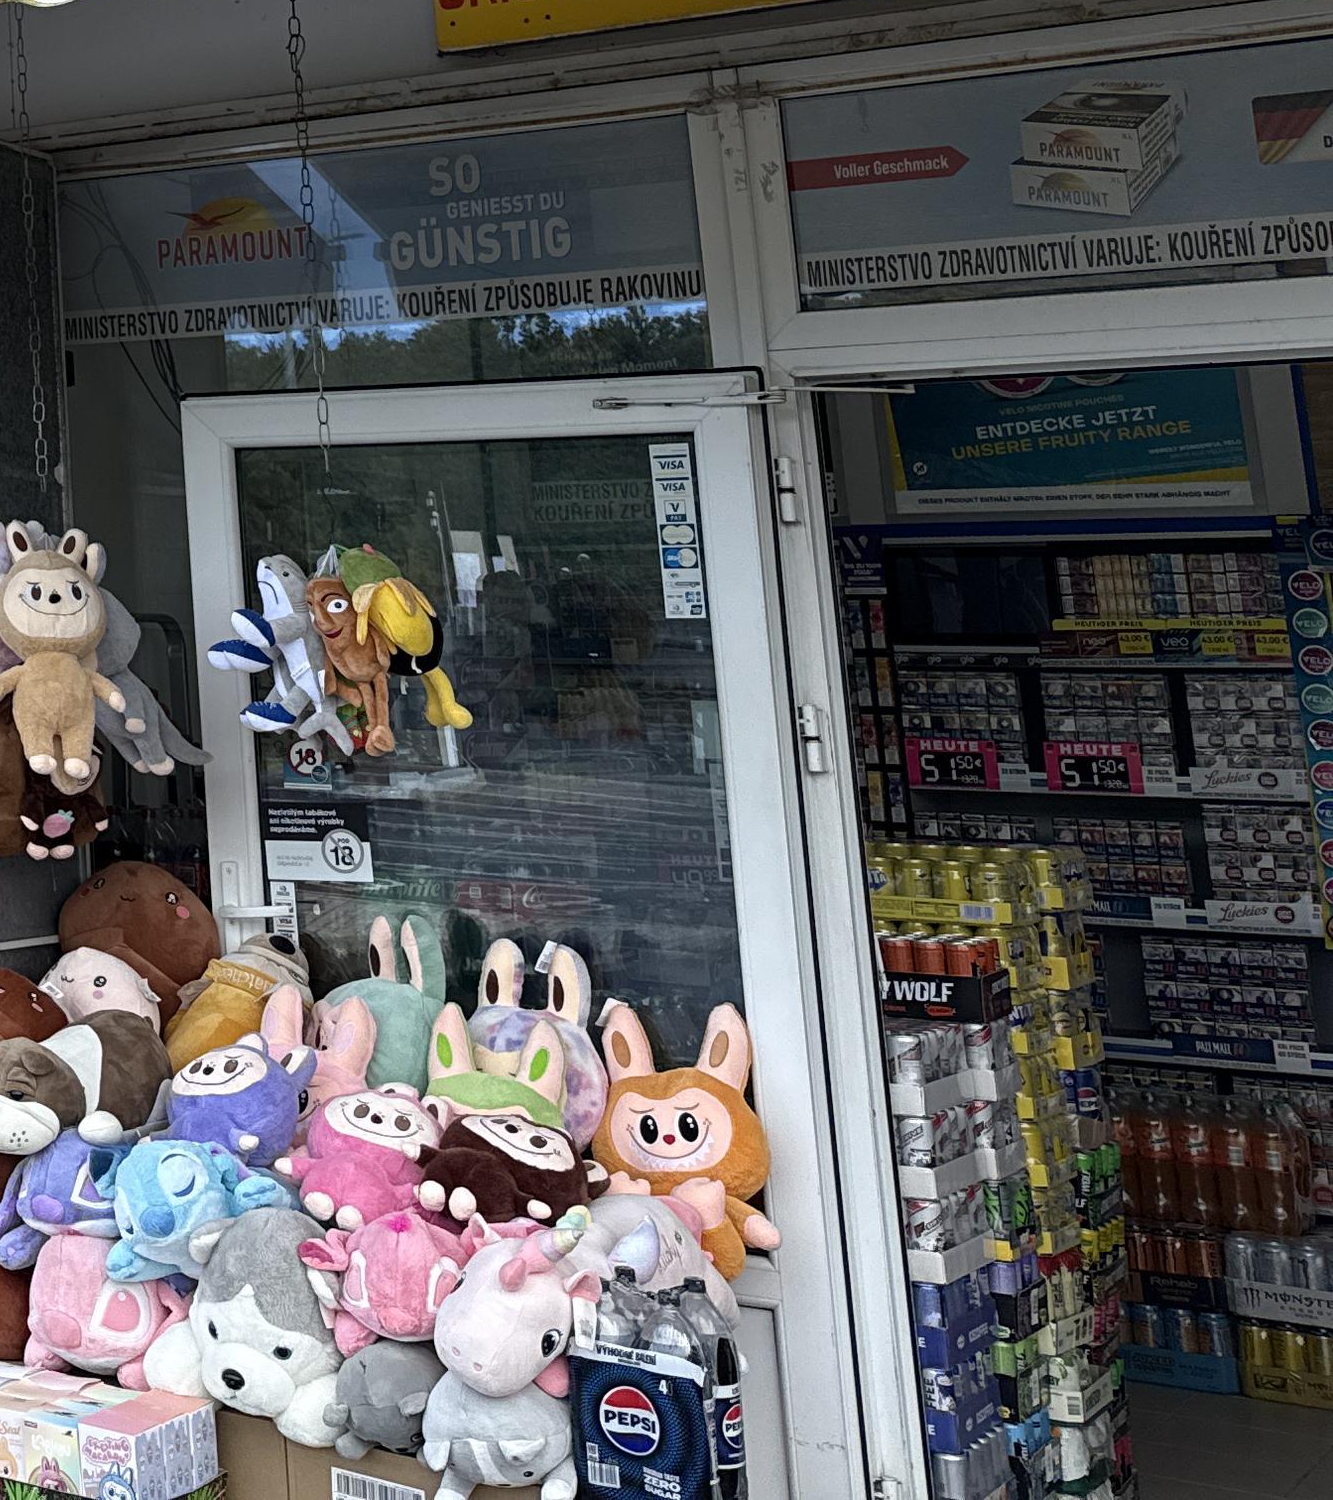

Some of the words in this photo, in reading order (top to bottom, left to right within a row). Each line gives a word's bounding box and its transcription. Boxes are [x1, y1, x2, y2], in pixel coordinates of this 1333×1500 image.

[1039, 142, 1122, 164] PARAMOUNT
[429, 155, 481, 197] SO
[833, 161, 870, 180] Voller
[872, 155, 950, 178] Geschmack
[446, 194, 534, 220] GENIESST
[540, 191, 565, 210] DU
[1028, 186, 1111, 208] PARAMOUNT
[158, 226, 310, 268] PARAMOUNT
[390, 217, 571, 272] GÜNSTIG
[807, 254, 932, 288] MINISTERSTVO
[939, 235, 1078, 280] ZDRAVOTNICTVÍ
[1083, 234, 1163, 270] VARUJE:
[1168, 221, 1257, 262] KOUŘENÍ
[64, 306, 180, 342] MINISTERSTVO
[184, 298, 314, 335] ZDRAVOTNICTVÍ
[315, 296, 391, 328] VARUJE:
[397, 280, 478, 319] KOUŘENÍ
[483, 276, 594, 313] ZPŮSOBUJE
[600, 268, 702, 304] RAKOVINU
[975, 415, 1085, 440] ENTDECKE
[1091, 405, 1158, 425] JETZT
[951, 436, 1035, 460] UNSERE
[1038, 428, 1112, 449] FRUITY
[1116, 420, 1192, 441] RANGE
[658, 459, 685, 470] VISA
[661, 482, 686, 492] VISA
[294, 747, 317, 767] 18
[919, 740, 979, 752] HEUTE
[1059, 743, 1123, 755] HEUTE
[1204, 770, 1253, 790] Luckies
[330, 845, 355, 867] 18
[1218, 903, 1269, 923] Luckies
[894, 982, 955, 1002] WOLF
[604, 1409, 657, 1435] PEPSI
[643, 1474, 682, 1493] ZERO
[644, 1485, 682, 1500] SUGAR
